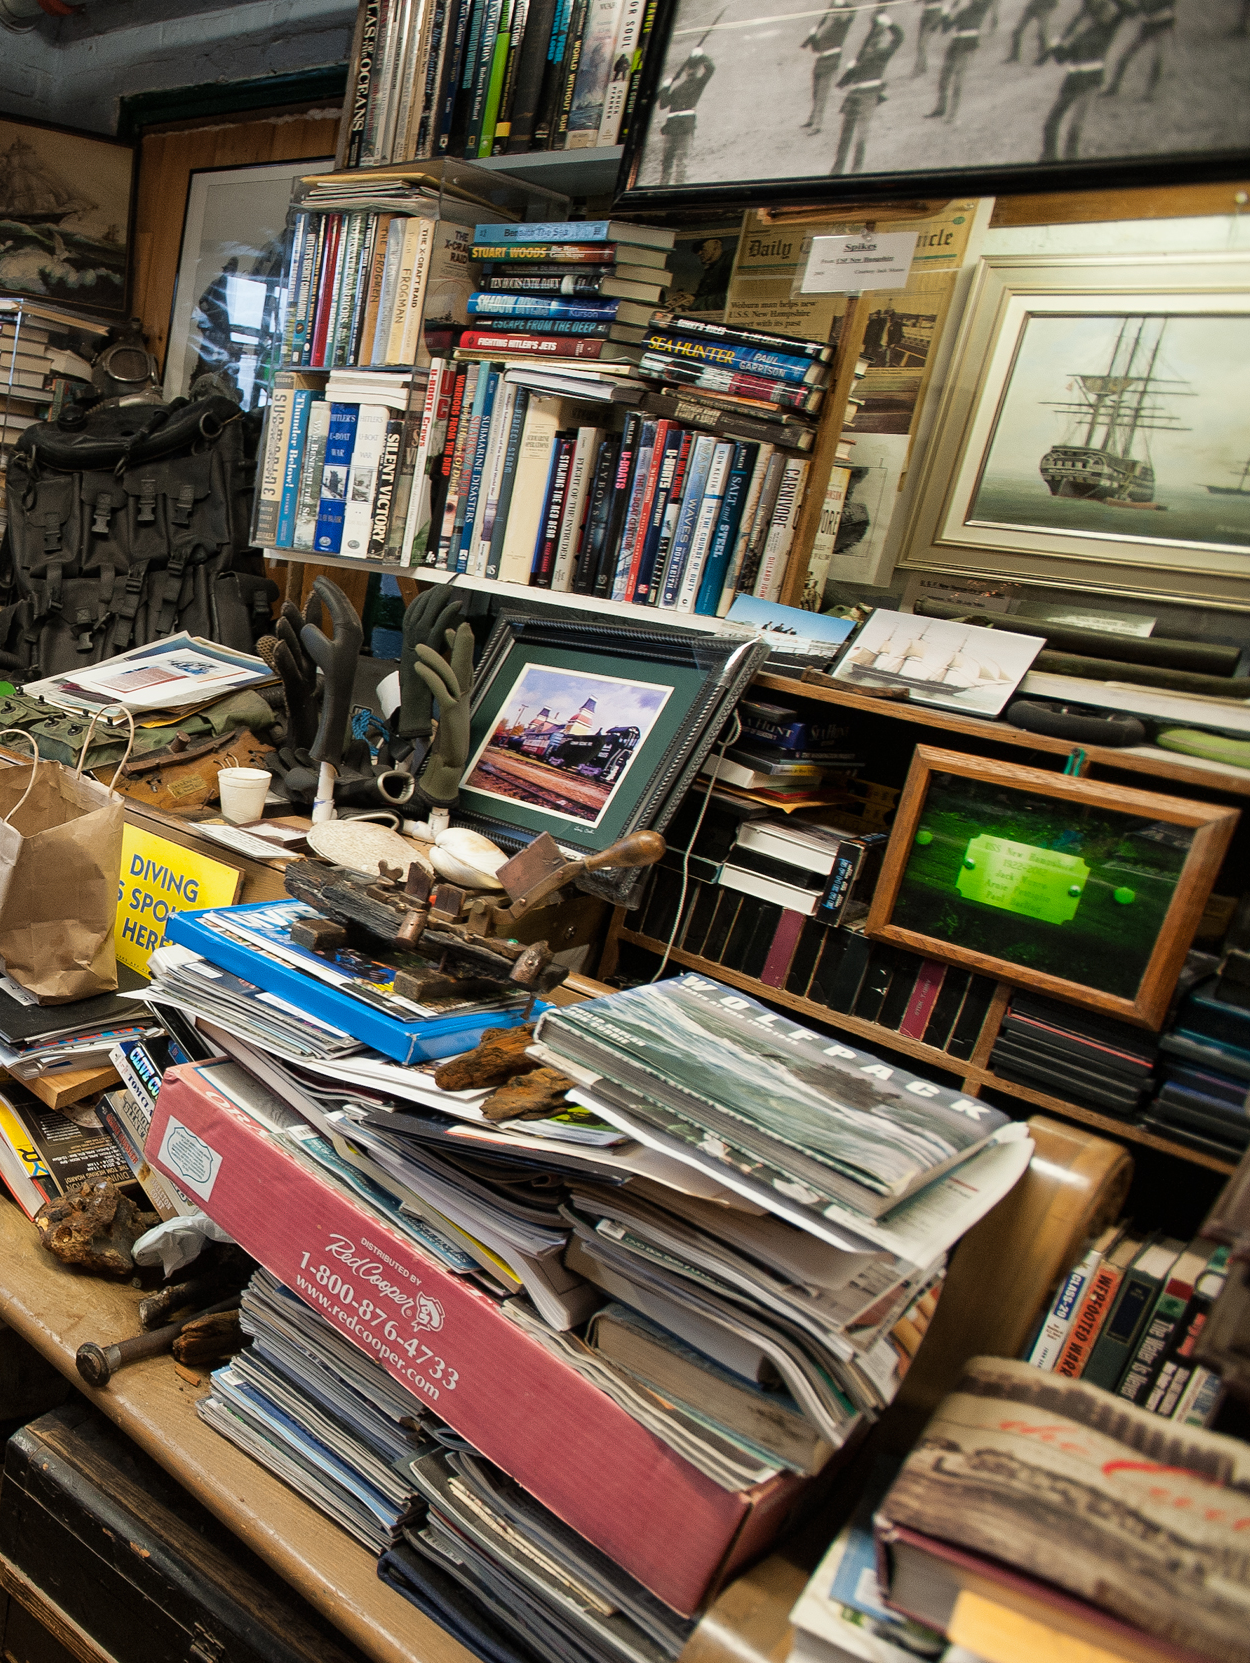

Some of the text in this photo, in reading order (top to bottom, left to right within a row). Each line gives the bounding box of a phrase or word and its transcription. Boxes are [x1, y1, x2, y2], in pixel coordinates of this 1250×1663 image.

[432, 28, 441, 46] blue
[621, 21, 636, 48] SOUL
[426, 52, 438, 94] continent
[559, 40, 582, 132] WORLD WITHOUT SUN
[352, 58, 372, 131] OCEANS
[472, 98, 480, 120] Ballard
[456, 230, 468, 242] THE
[472, 247, 547, 258] STUART WOODS
[749, 240, 792, 258] Daily
[844, 243, 877, 252] Spikes
[370, 254, 386, 302] FROGMEN
[412, 228, 429, 308] THE X-CRAFT RAID
[296, 260, 312, 320] SECRET COMMANDOS
[340, 279, 354, 322] WARRIORS
[395, 268, 412, 324] FROGMAN
[476, 294, 517, 313] SHADOW
[779, 300, 800, 310] helps
[326, 302, 338, 342] FROGMAN
[493, 320, 596, 332] ESCAPE FROM THE DEEP
[568, 309, 598, 318] Kurson
[770, 310, 810, 319] Hampshire
[784, 320, 801, 328] past
[478, 337, 557, 350] FIGHTING HITLER'S JETS
[648, 336, 735, 364] SEA HUNTER
[753, 353, 780, 364] PAUL
[739, 361, 786, 378] GARRISON
[286, 394, 306, 488] Thunder Below!
[419, 417, 430, 447] Crews
[441, 374, 466, 476] WARRIORS FROM THE DEEP
[466, 415, 481, 455] SHARKS
[510, 409, 522, 446] PERFECT
[307, 442, 319, 484] BENEATH
[466, 415, 490, 523] SUBMARINE DISASTERS
[615, 420, 636, 490] MILLER U-BOATS
[659, 450, 678, 489] U-BOATS
[677, 459, 686, 474] WAR
[372, 433, 400, 544] SILENT VICTORY
[552, 455, 570, 504] STALKING THE
[592, 450, 612, 516] FLYBOYS
[637, 474, 646, 490] THE
[712, 464, 721, 489] KEITH
[559, 458, 584, 560] FLIGHT OF THE INTRUDER
[680, 498, 698, 544] WAVES
[704, 514, 712, 529] THE
[712, 476, 742, 558] SALT and STEEL
[765, 468, 800, 580] CARNIVORE DILLARD
[666, 546, 683, 588] DON KEITH
[130, 854, 199, 903] DIVING
[129, 888, 181, 922] SPO
[130, 1046, 154, 1082] CLIVE
[128, 1074, 144, 1094] TOM
[360, 1238, 422, 1286] DISTRIBUTED BY
[1056, 1272, 1082, 1320] CLASS-20
[296, 1272, 440, 1400] www.redcooper.com
[300, 1251, 460, 1391] 1-800-876-4733
[1149, 1318, 1175, 1338] The
[1136, 1336, 1166, 1364] Water
